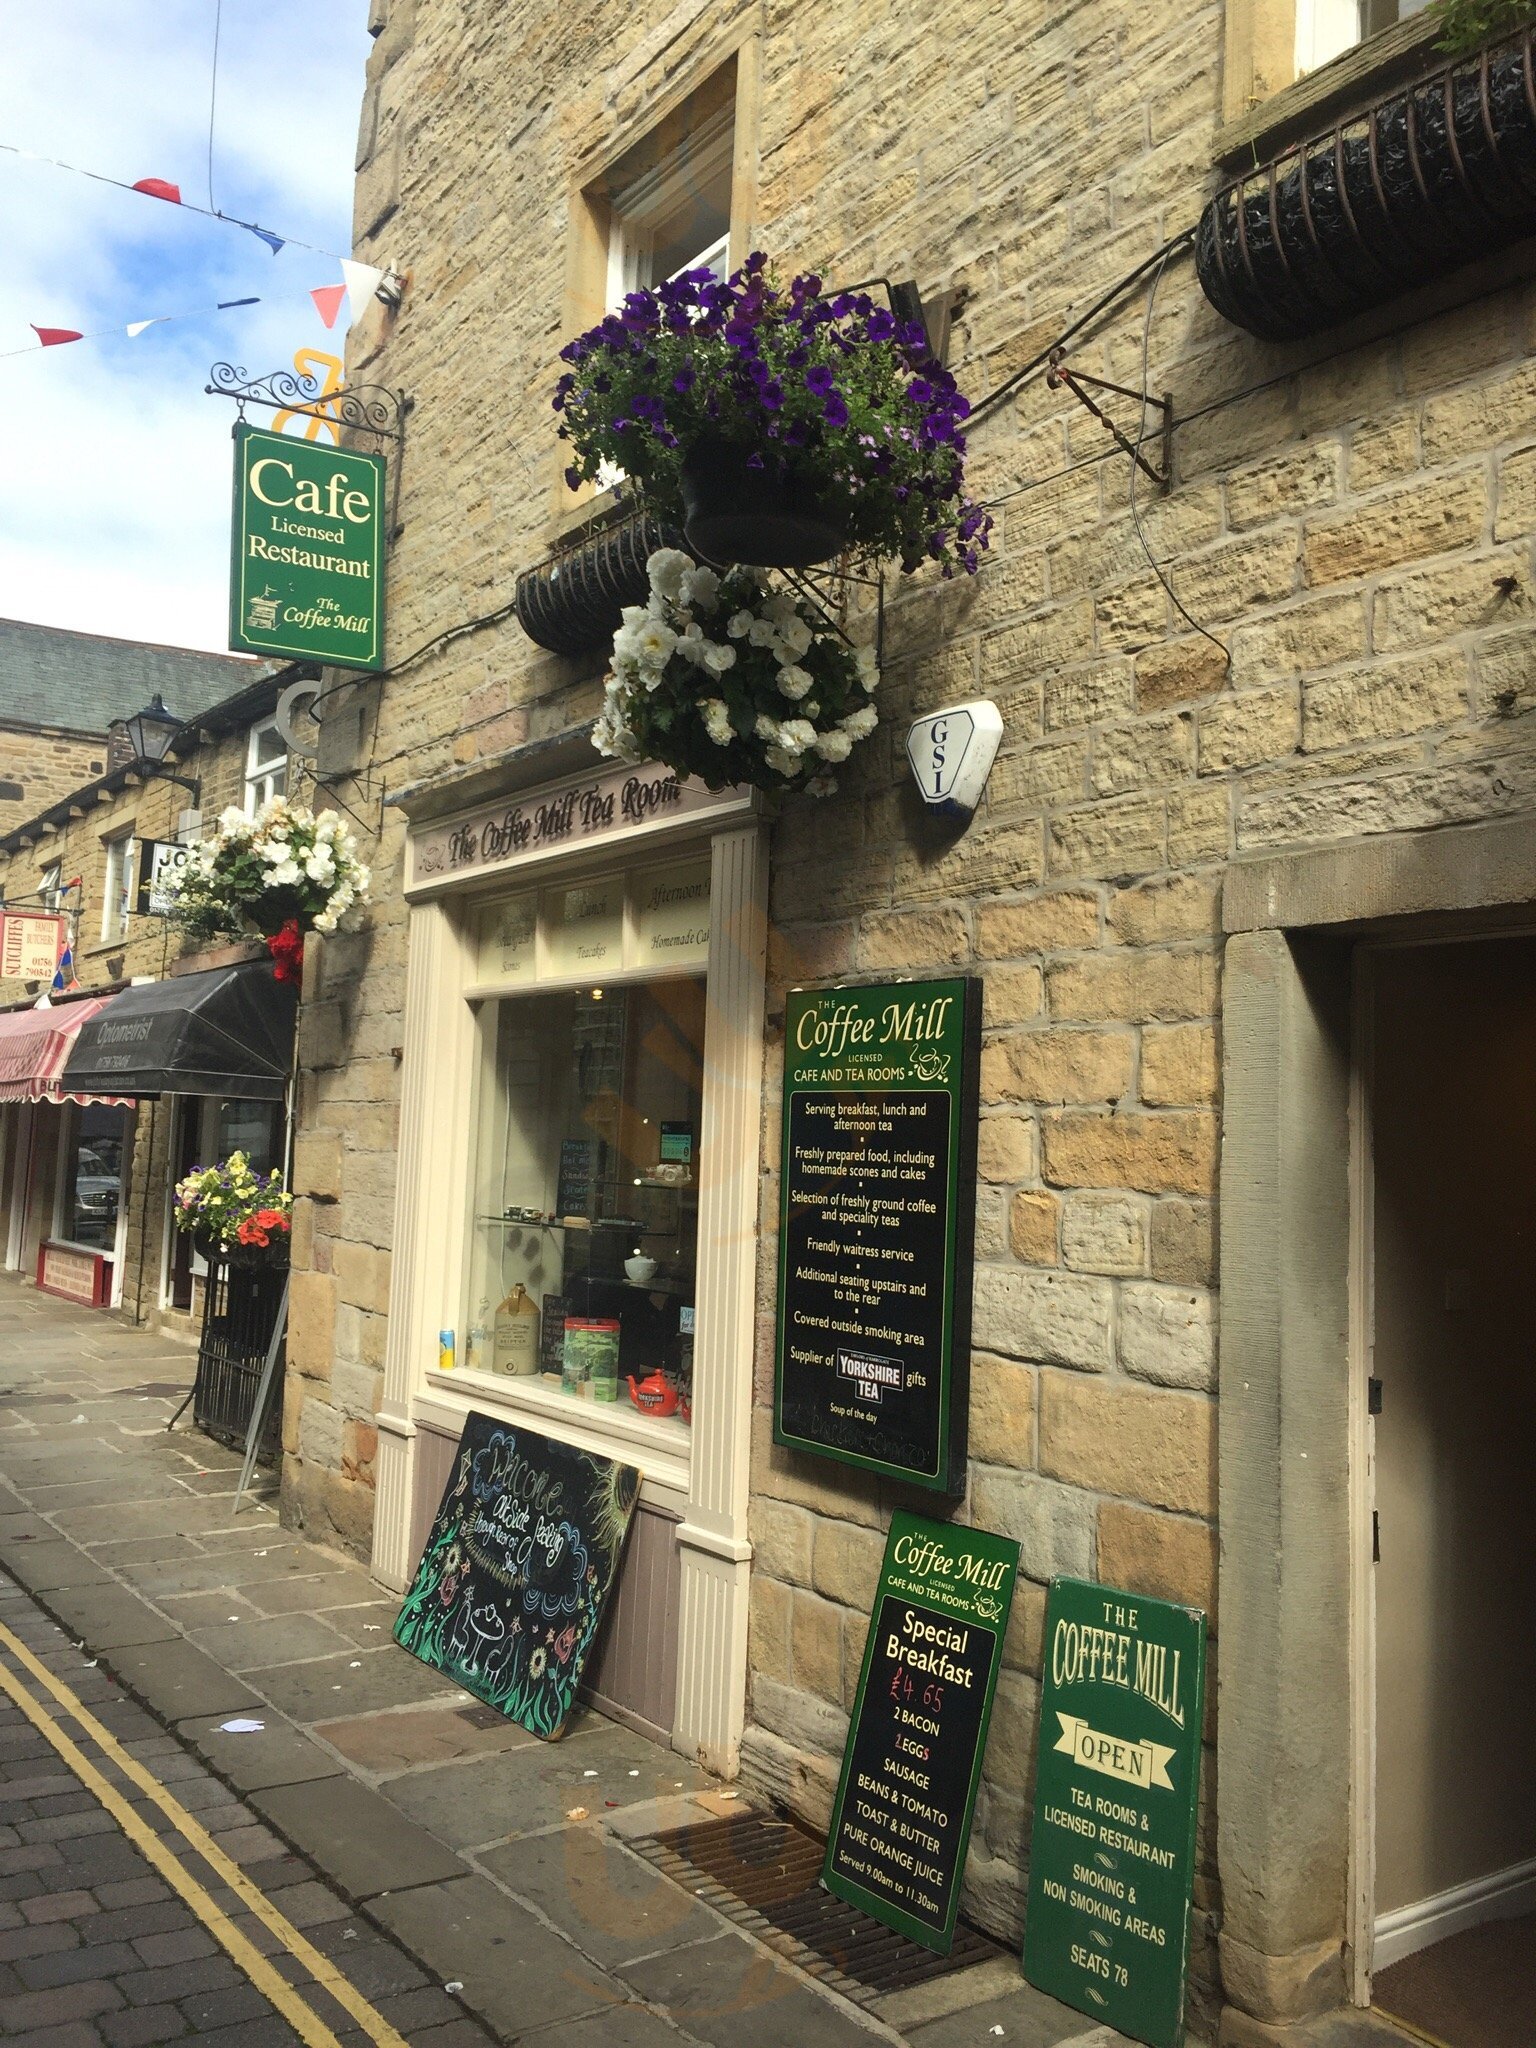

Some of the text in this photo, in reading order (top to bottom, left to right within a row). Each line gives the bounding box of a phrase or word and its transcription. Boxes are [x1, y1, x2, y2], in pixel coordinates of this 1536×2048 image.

[249, 458, 372, 523] Cafe
[271, 516, 345, 545] Licensed
[248, 534, 371, 579] Restaurant
[283, 606, 371, 634] Coffee Mill
[317, 597, 340, 612] The
[448, 823, 477, 862] The
[481, 808, 531, 857] Coffee
[533, 791, 579, 840] Mill
[580, 785, 614, 824] Tea
[649, 881, 703, 912] Afternoon
[5, 919, 24, 976] SUTCLIFFES
[577, 943, 607, 960] Teacakes
[651, 932, 694, 949] Homemade
[818, 1000, 836, 1009] THE
[97, 1017, 154, 1049] Optometrist
[796, 997, 953, 1057] Coffee Mill
[848, 1053, 883, 1063] LICENSED
[794, 1067, 905, 1082] CAFE AND TEA ROOMS
[805, 1102, 927, 1117] Serving breakfast, lunch and
[834, 1119, 893, 1131] afternoon tea
[795, 1146, 935, 1167] Freshly prepared food, including
[801, 1162, 926, 1180] homemade scones and cakes
[791, 1190, 937, 1214] Selection of freshly ground coffee
[821, 1209, 900, 1228] and speciality teas
[807, 1237, 914, 1262] Friendly waitress service
[796, 1266, 927, 1296] Additional seating upstairs and
[834, 1289, 881, 1306] to the rear
[794, 1310, 925, 1346] Covered outside smoking area
[790, 1346, 927, 1387] Supplier of YORKSHIRE gifts
[858, 1380, 879, 1400] TEA
[829, 1402, 878, 1425] Soup of the day
[914, 1532, 928, 1542] THE
[894, 1535, 1010, 1591] Coffee Mill
[888, 1575, 969, 1611] CAFE AND TEA ROOMS
[929, 1579, 956, 1592] LICENSED
[902, 1610, 969, 1654] Special
[1103, 1602, 1139, 1631] THE
[886, 1634, 974, 1688] Breakfast
[1053, 1618, 1185, 1731] COFFEE MILL
[893, 1706, 940, 1737] 2 BACON
[902, 1738, 930, 1761] EGGS
[1081, 1735, 1143, 1777] OPEN
[883, 1757, 930, 1791] SAUSAGE
[857, 1773, 948, 1828] BEANS & TOMATO
[1070, 1787, 1149, 1831] TEA ROOMS &
[856, 1800, 940, 1855] TOAST & BUTTER
[1044, 1805, 1175, 1870] LICENSED RESTAURANT
[843, 1822, 943, 1887] PURE ORANGE JUICE
[839, 1849, 940, 1914] Served 9.00am to 11.30am
[1073, 1863, 1137, 1905] SMOKING &
[1043, 1879, 1166, 1947] NON SMOKING AREAS
[1071, 1944, 1128, 1987] SEATS 78
